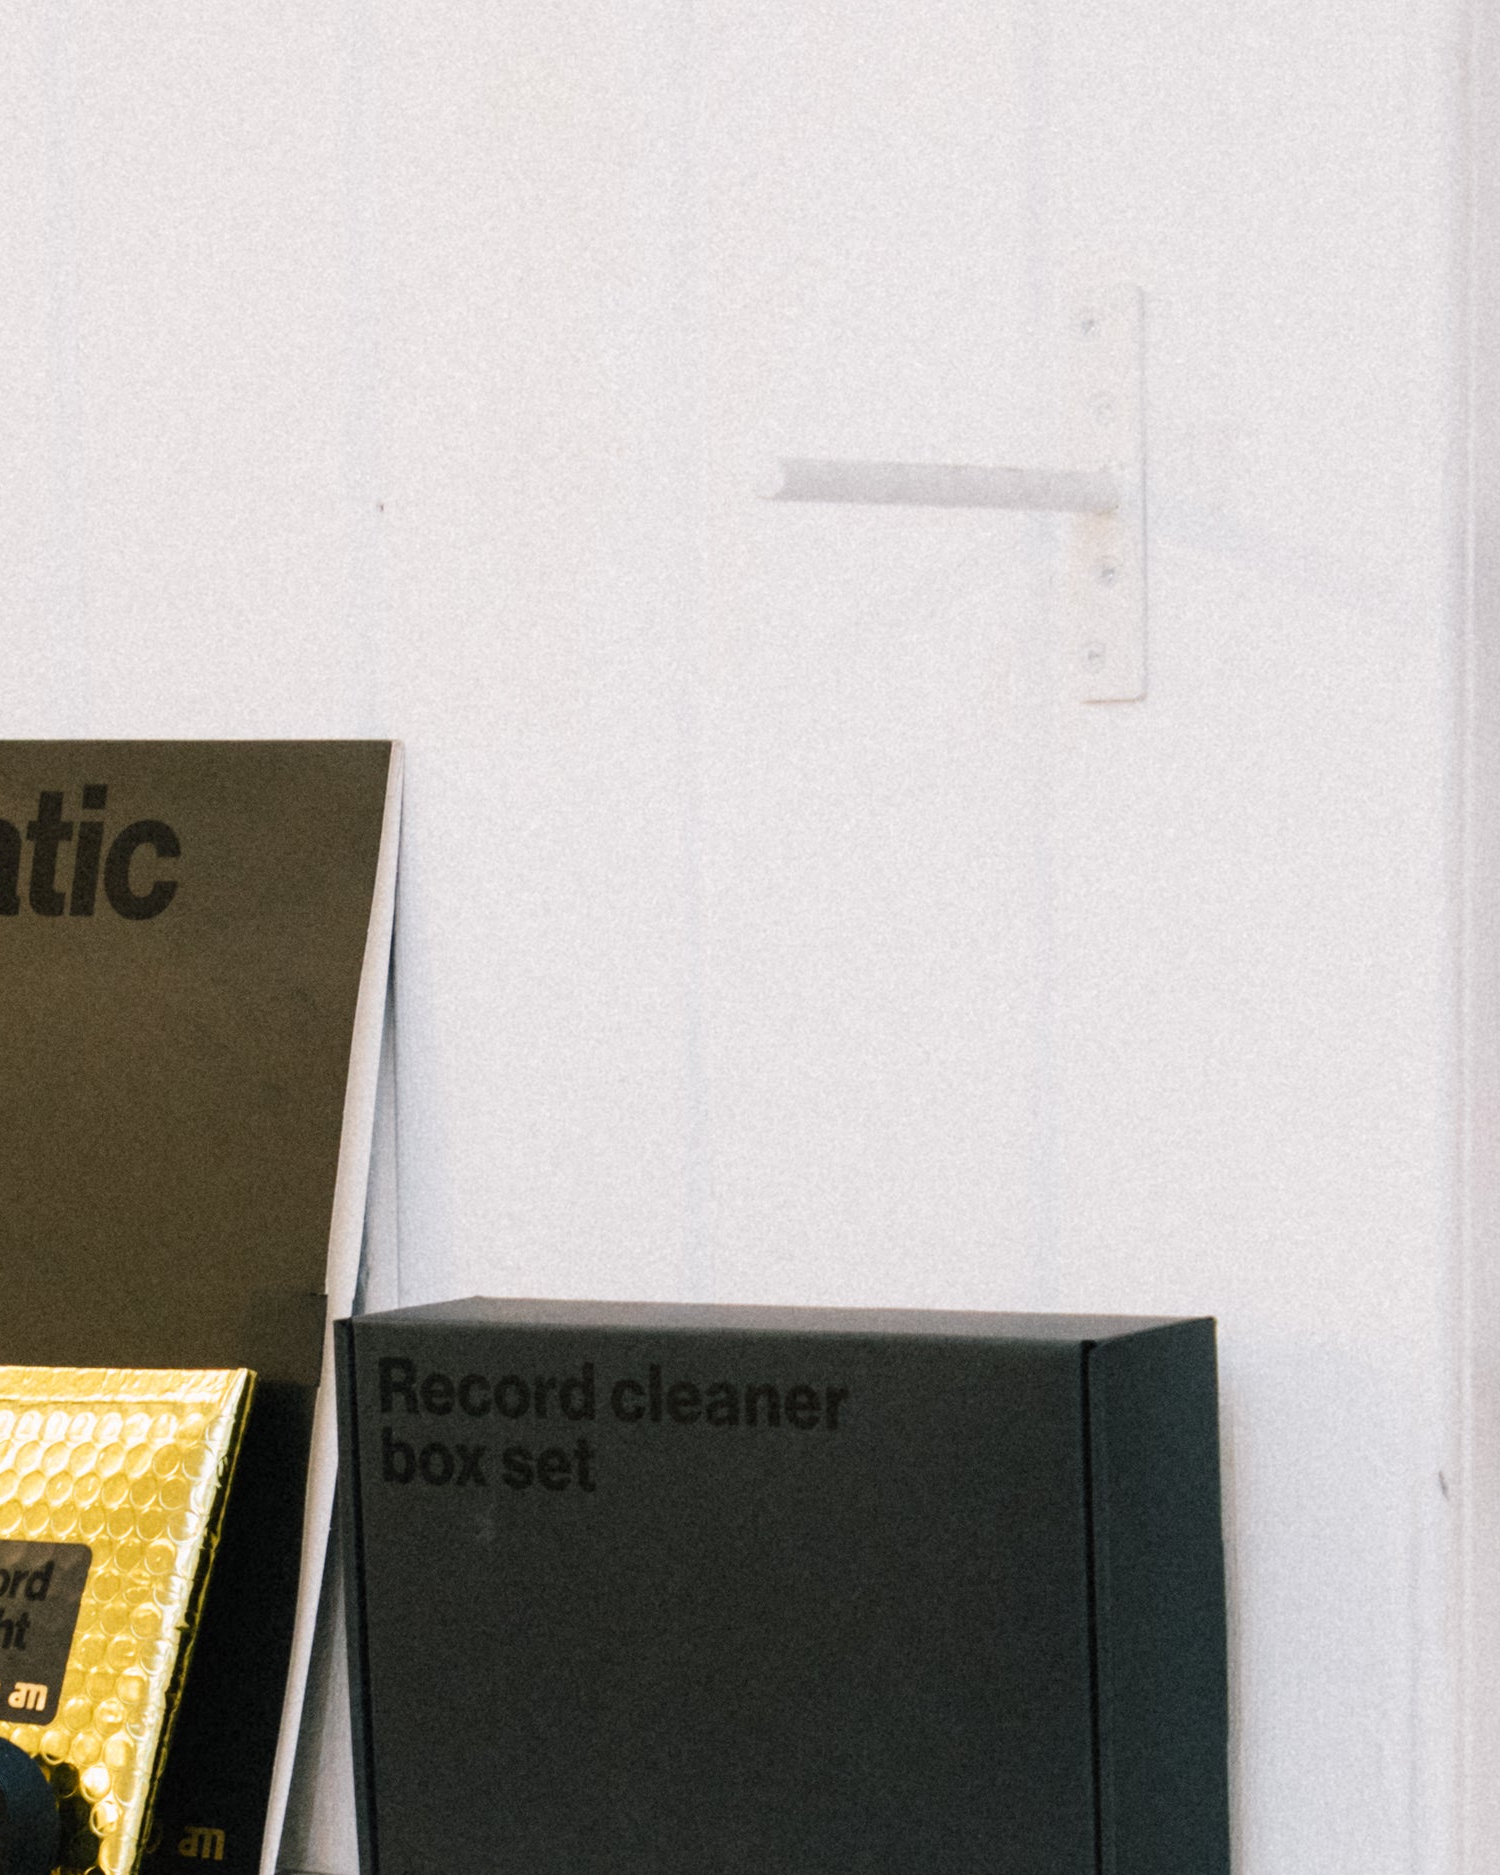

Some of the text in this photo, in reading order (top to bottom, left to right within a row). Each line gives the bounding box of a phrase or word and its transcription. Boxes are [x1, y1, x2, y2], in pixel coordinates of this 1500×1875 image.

[377, 1356, 848, 1430] Record cleaner
[381, 1427, 597, 1492] box set
[8, 1681, 48, 1712] am
